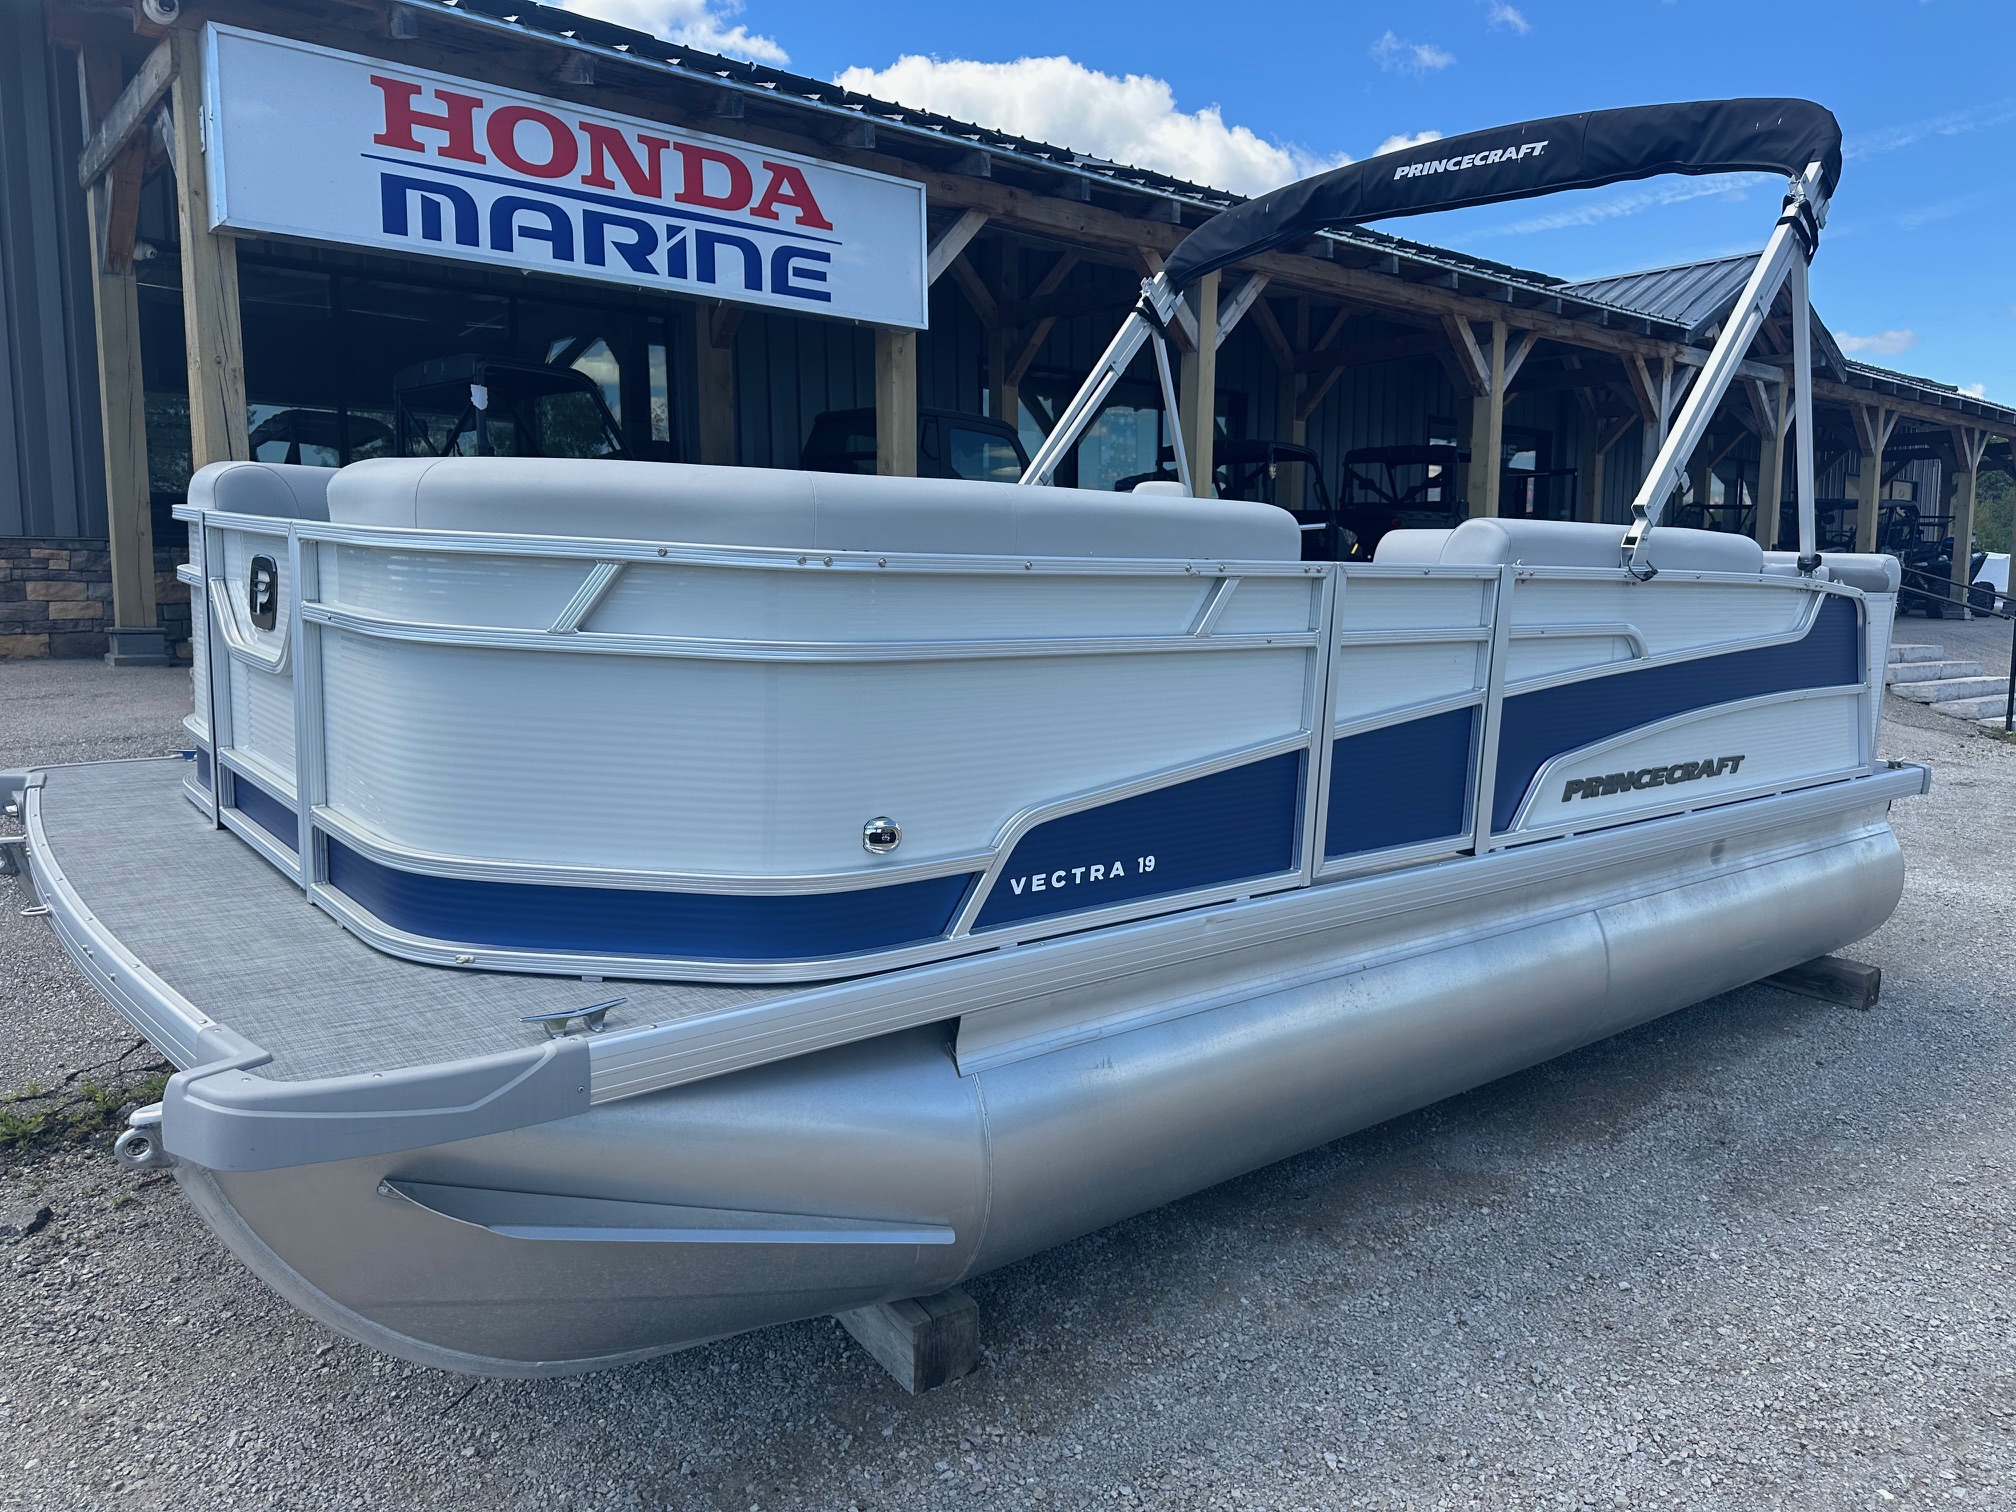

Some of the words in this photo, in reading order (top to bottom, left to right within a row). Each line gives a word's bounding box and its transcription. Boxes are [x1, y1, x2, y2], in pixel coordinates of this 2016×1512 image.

[369, 74, 834, 232] HONDA
[1393, 140, 1549, 181] PRINCECRAFT
[380, 171, 832, 303] MARINE
[1561, 754, 1746, 803] PRINCECRAFT
[1010, 861, 1125, 895] VECTRA
[1137, 855, 1156, 873] 19
